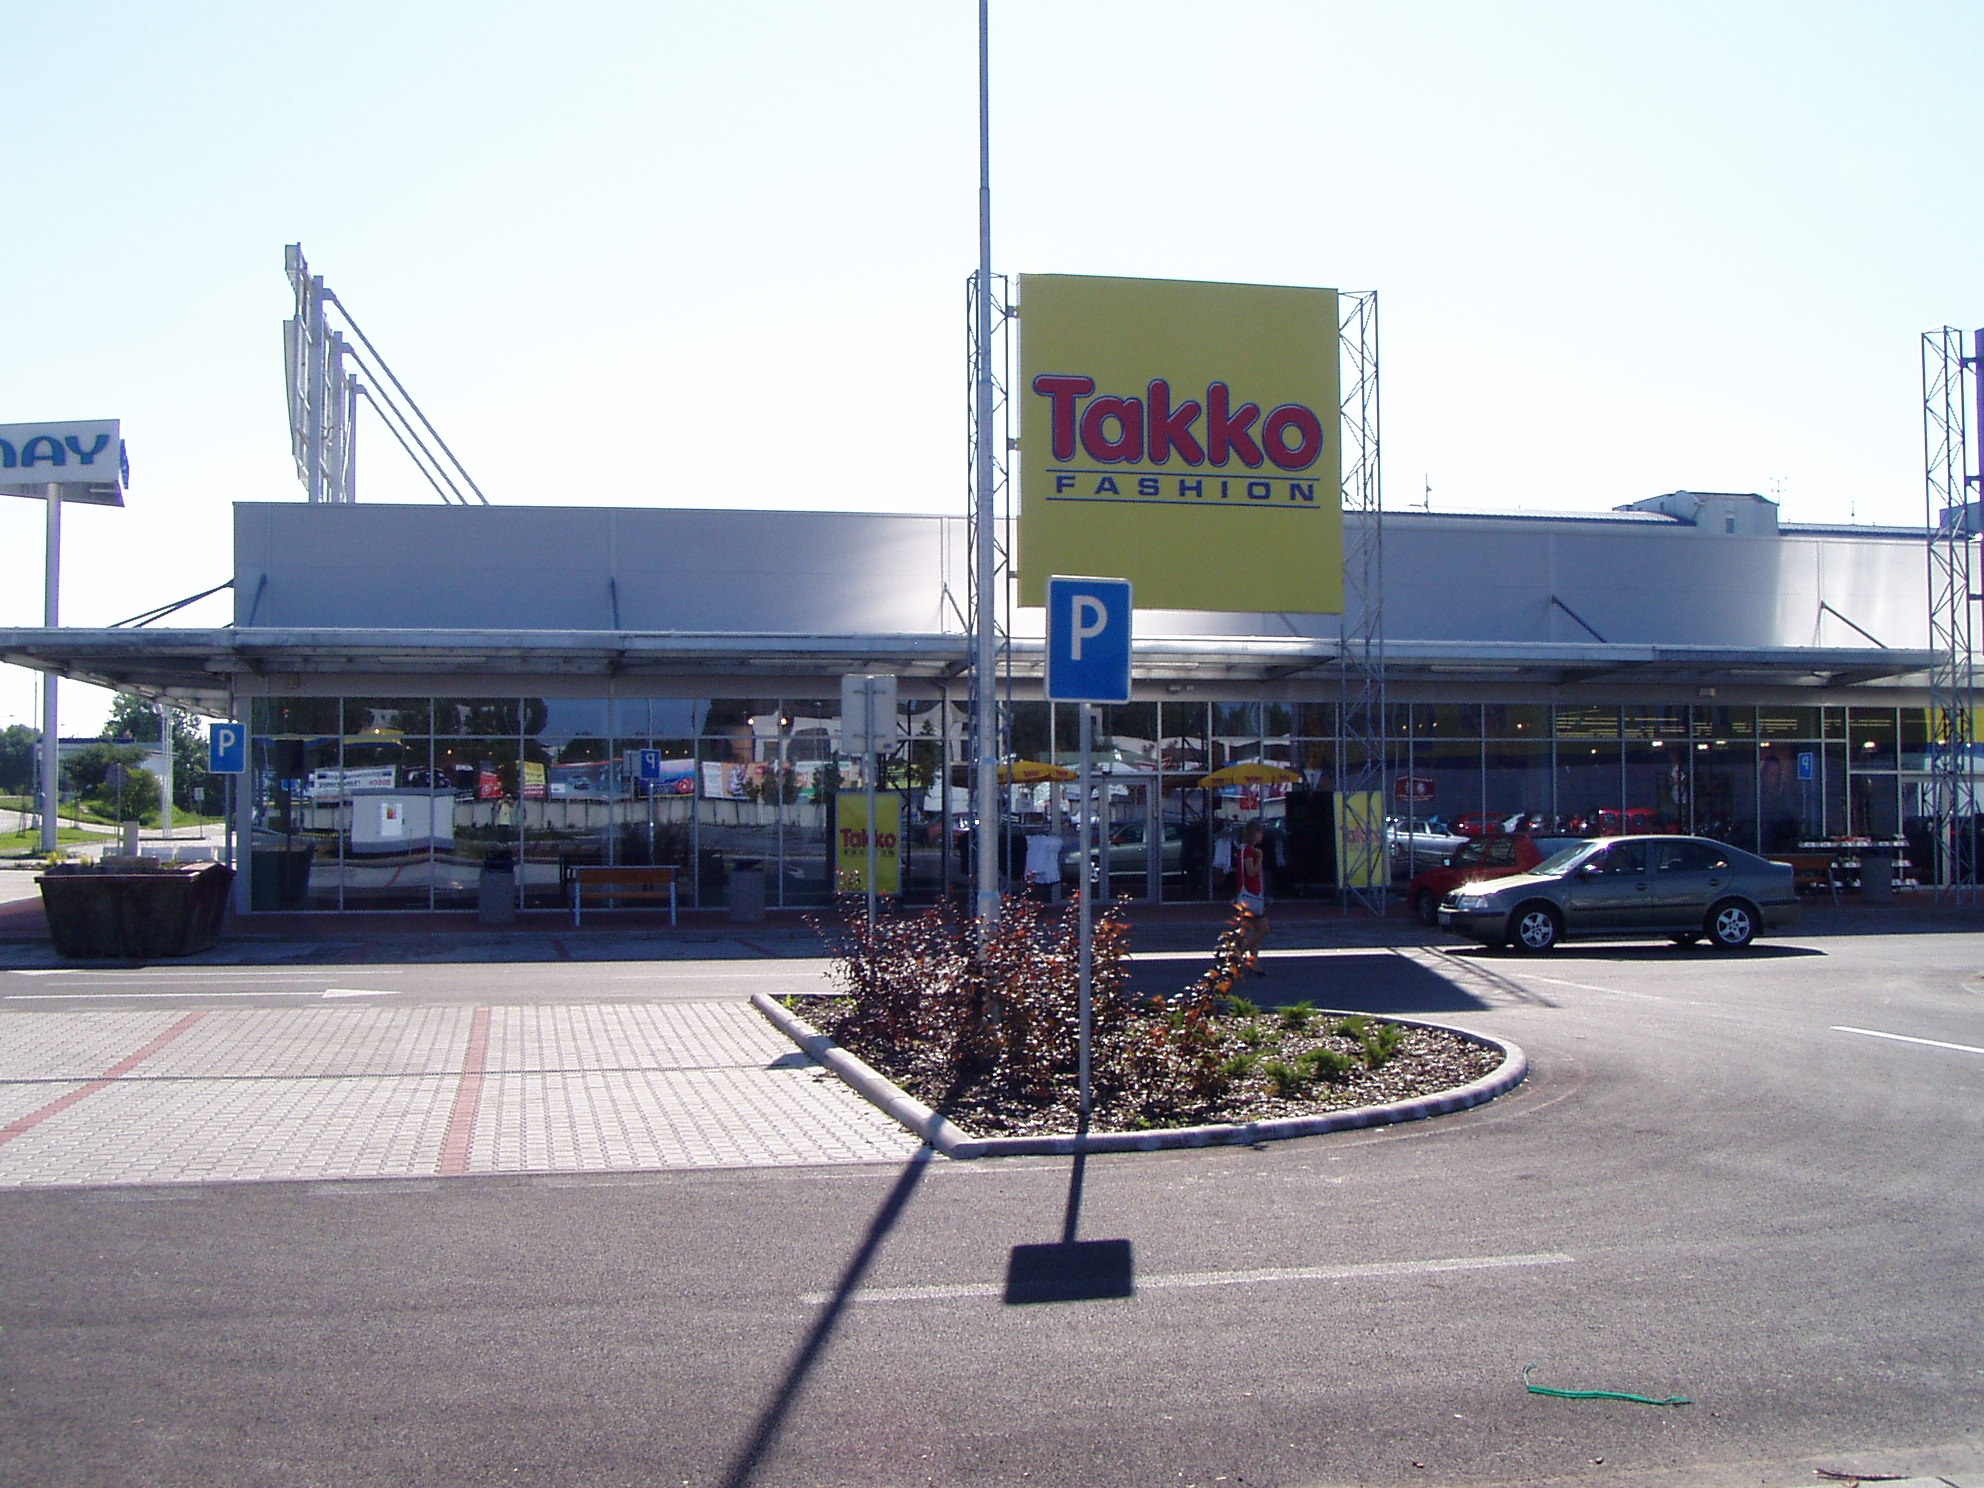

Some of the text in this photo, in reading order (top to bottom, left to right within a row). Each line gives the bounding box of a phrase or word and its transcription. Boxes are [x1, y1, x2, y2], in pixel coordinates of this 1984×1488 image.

[1033, 374, 1322, 471] Takko
[1056, 475, 1314, 502] FASHION
[1071, 595, 1108, 660] P
[219, 728, 236, 757] P
